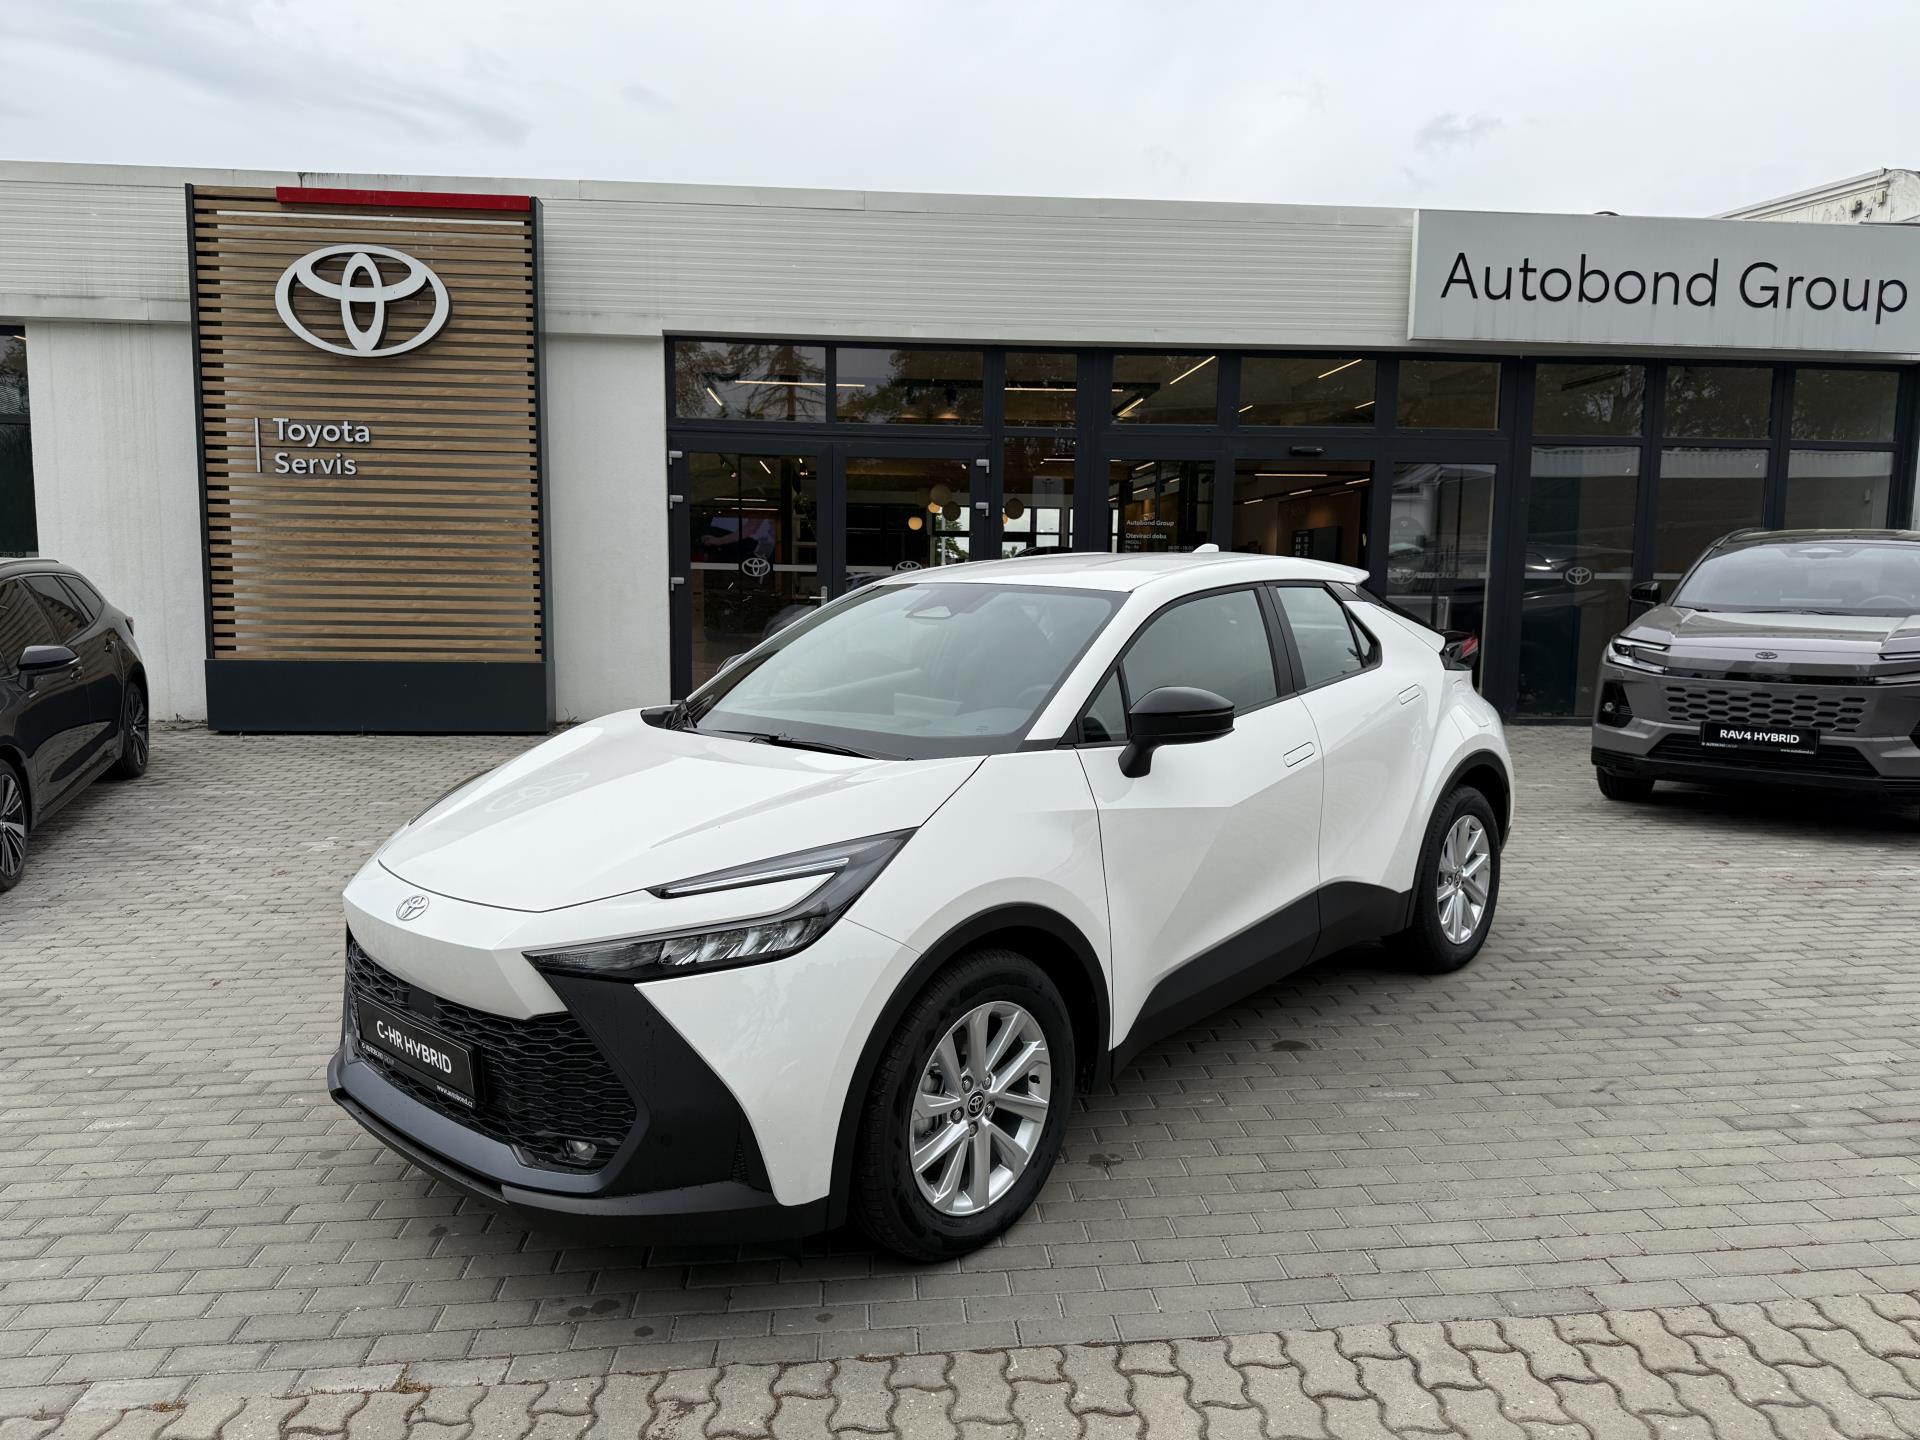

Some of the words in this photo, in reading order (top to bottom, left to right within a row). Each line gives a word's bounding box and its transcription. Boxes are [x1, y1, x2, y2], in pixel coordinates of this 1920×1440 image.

[1441, 252, 1720, 307] Autobond
[1739, 262, 1908, 324] Group
[272, 417, 370, 447] Toyota
[274, 452, 357, 475] Servis
[1720, 729, 1751, 740] RAV4
[1754, 732, 1799, 744] HYBRID
[376, 1020, 404, 1050] C-HR
[404, 1035, 452, 1074] HYBRID
